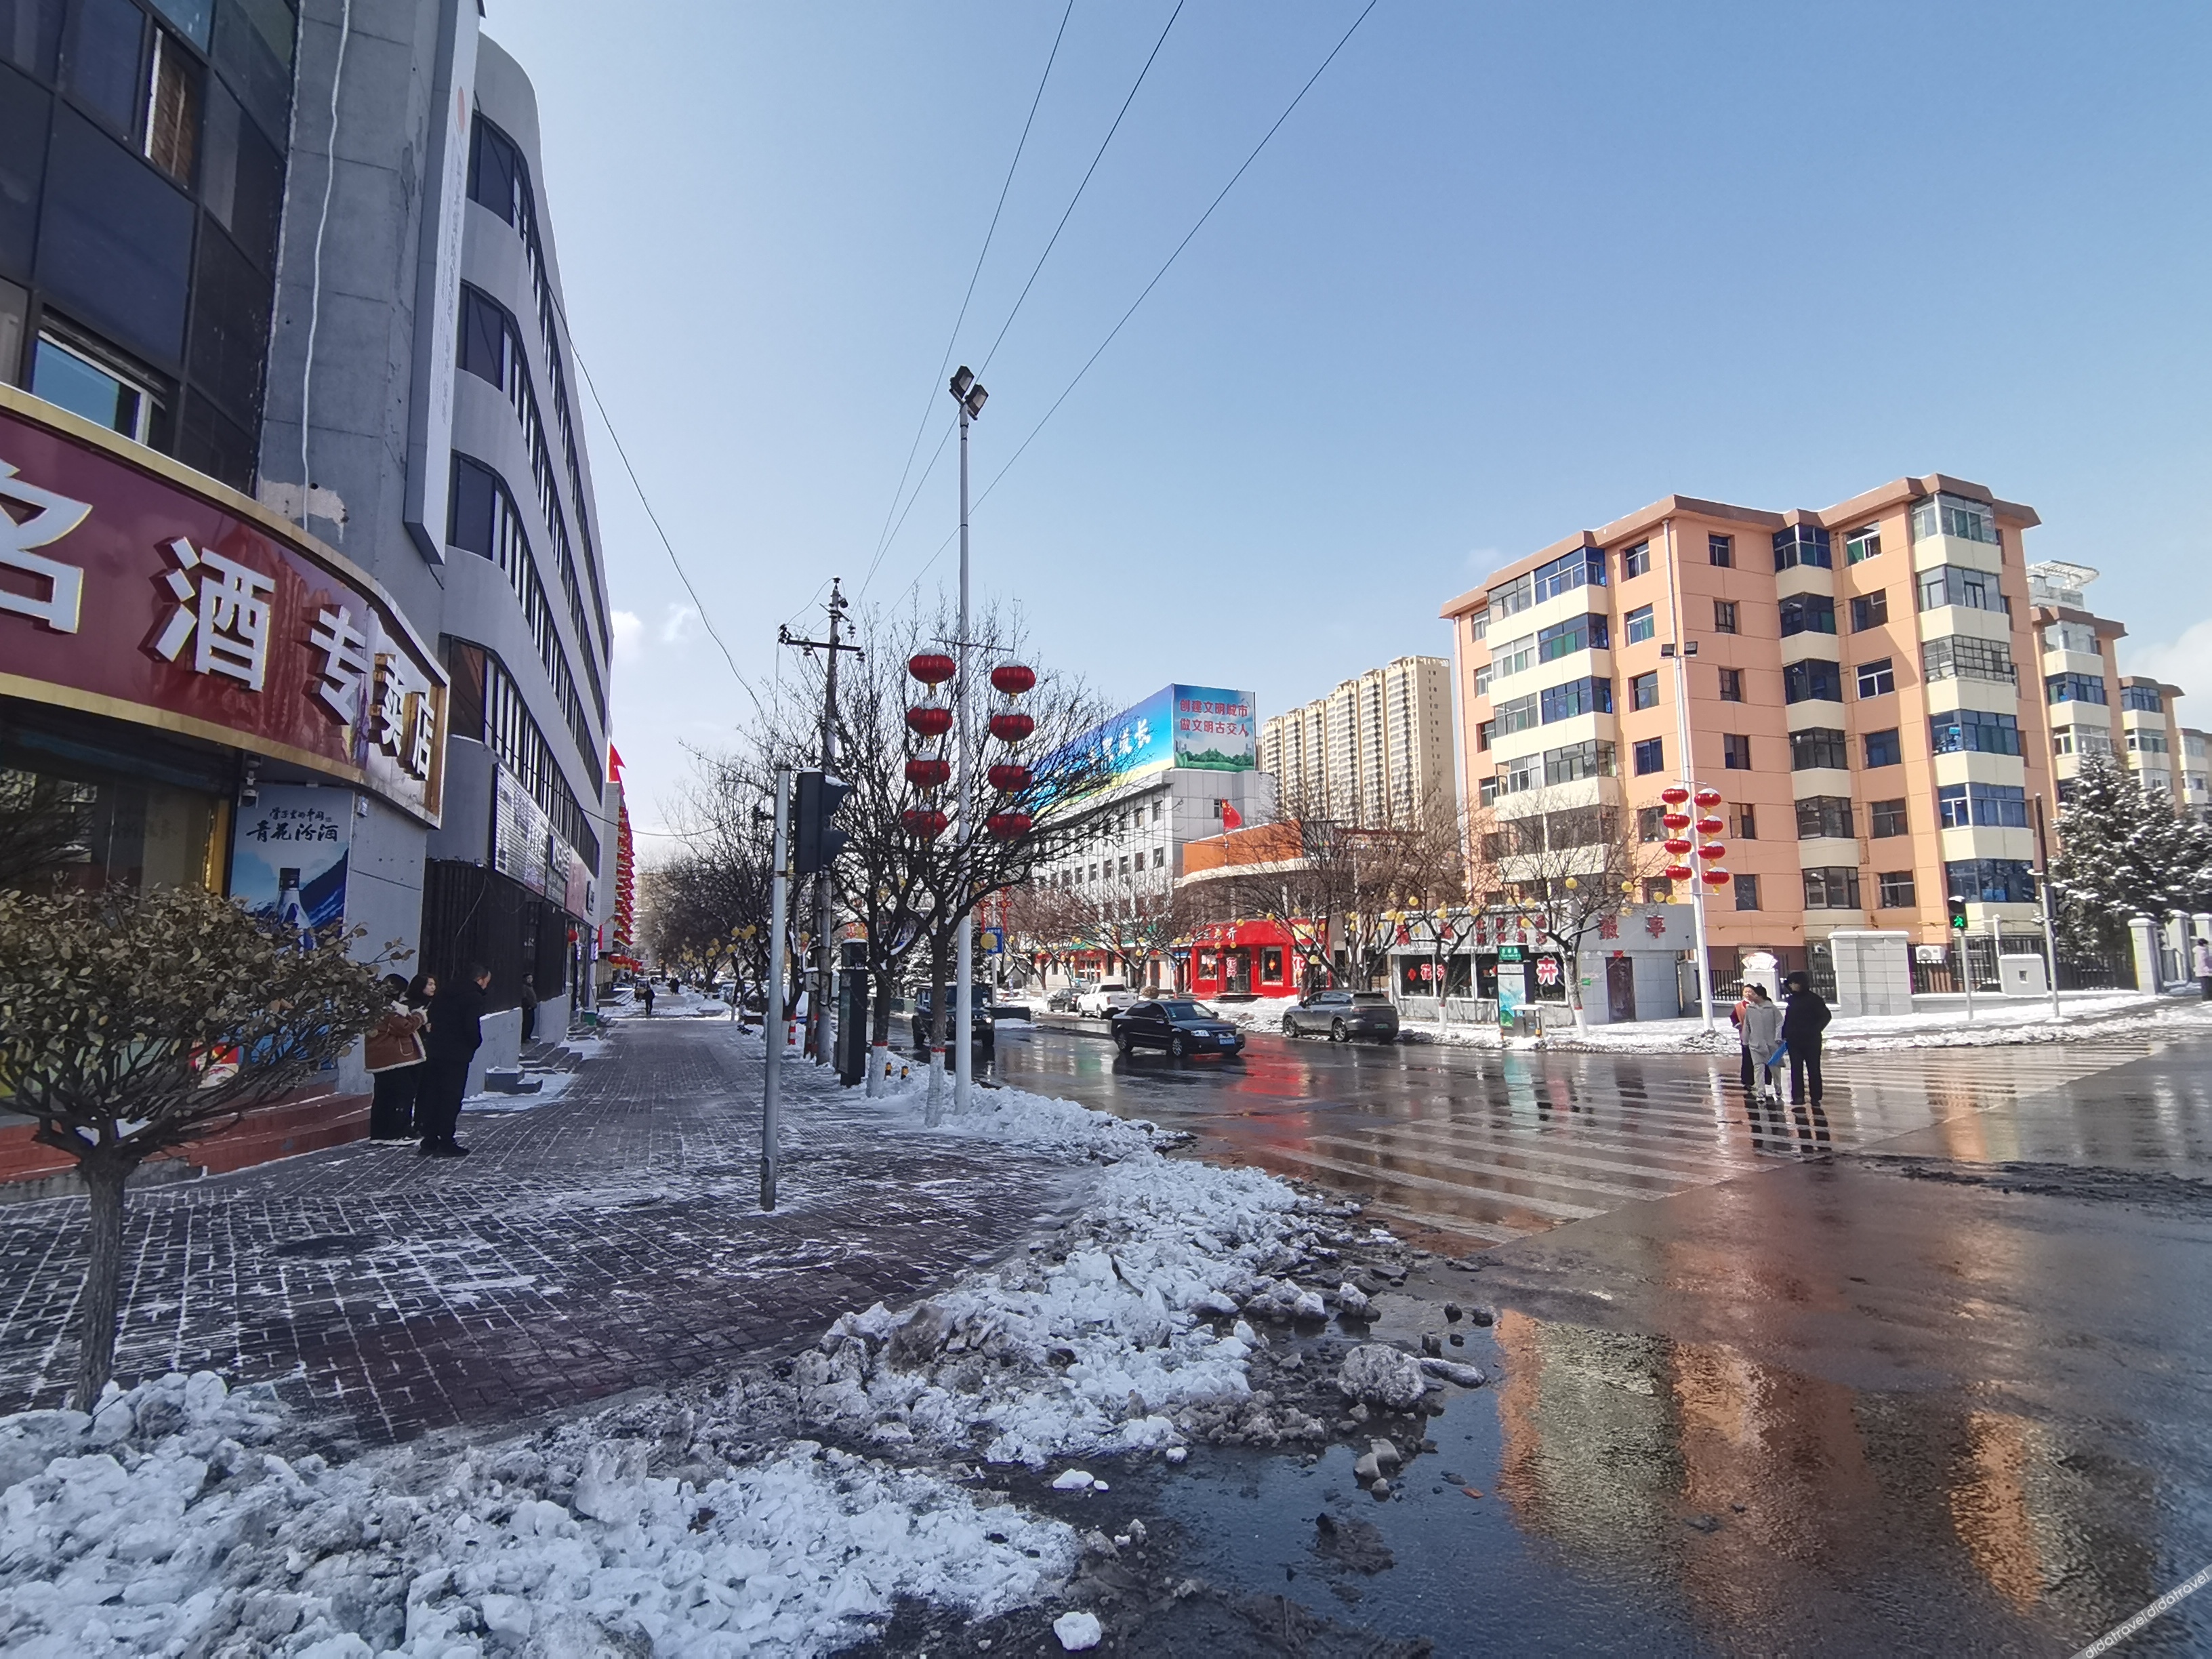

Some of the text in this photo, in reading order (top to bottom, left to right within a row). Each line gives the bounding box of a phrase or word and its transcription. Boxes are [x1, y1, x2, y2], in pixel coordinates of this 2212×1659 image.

[1179, 698, 1248, 718] 创建文明城市
[1179, 718, 1249, 736] 做文明古交人
[246, 819, 339, 843] 青花汾酒
